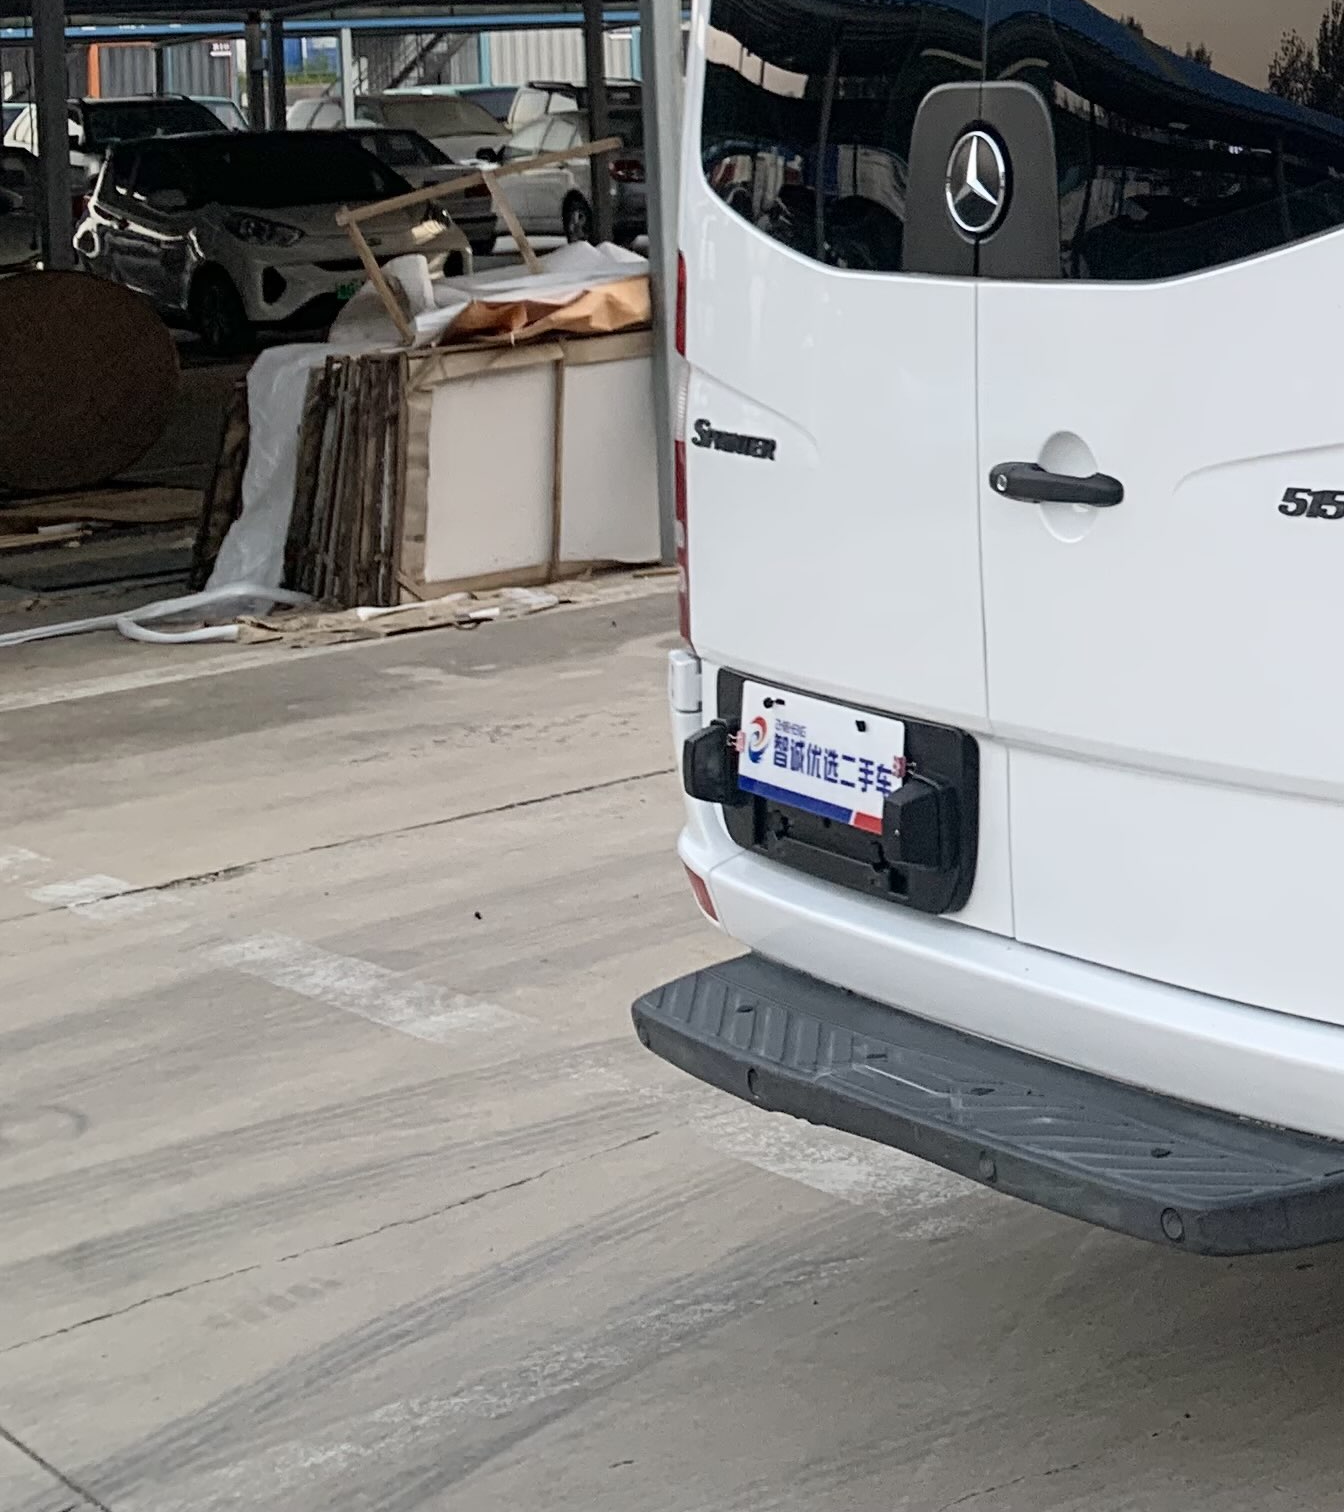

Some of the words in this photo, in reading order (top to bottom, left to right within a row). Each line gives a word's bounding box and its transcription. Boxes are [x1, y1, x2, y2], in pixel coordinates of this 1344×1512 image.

[773, 733, 894, 799] 智诚优选二手车
